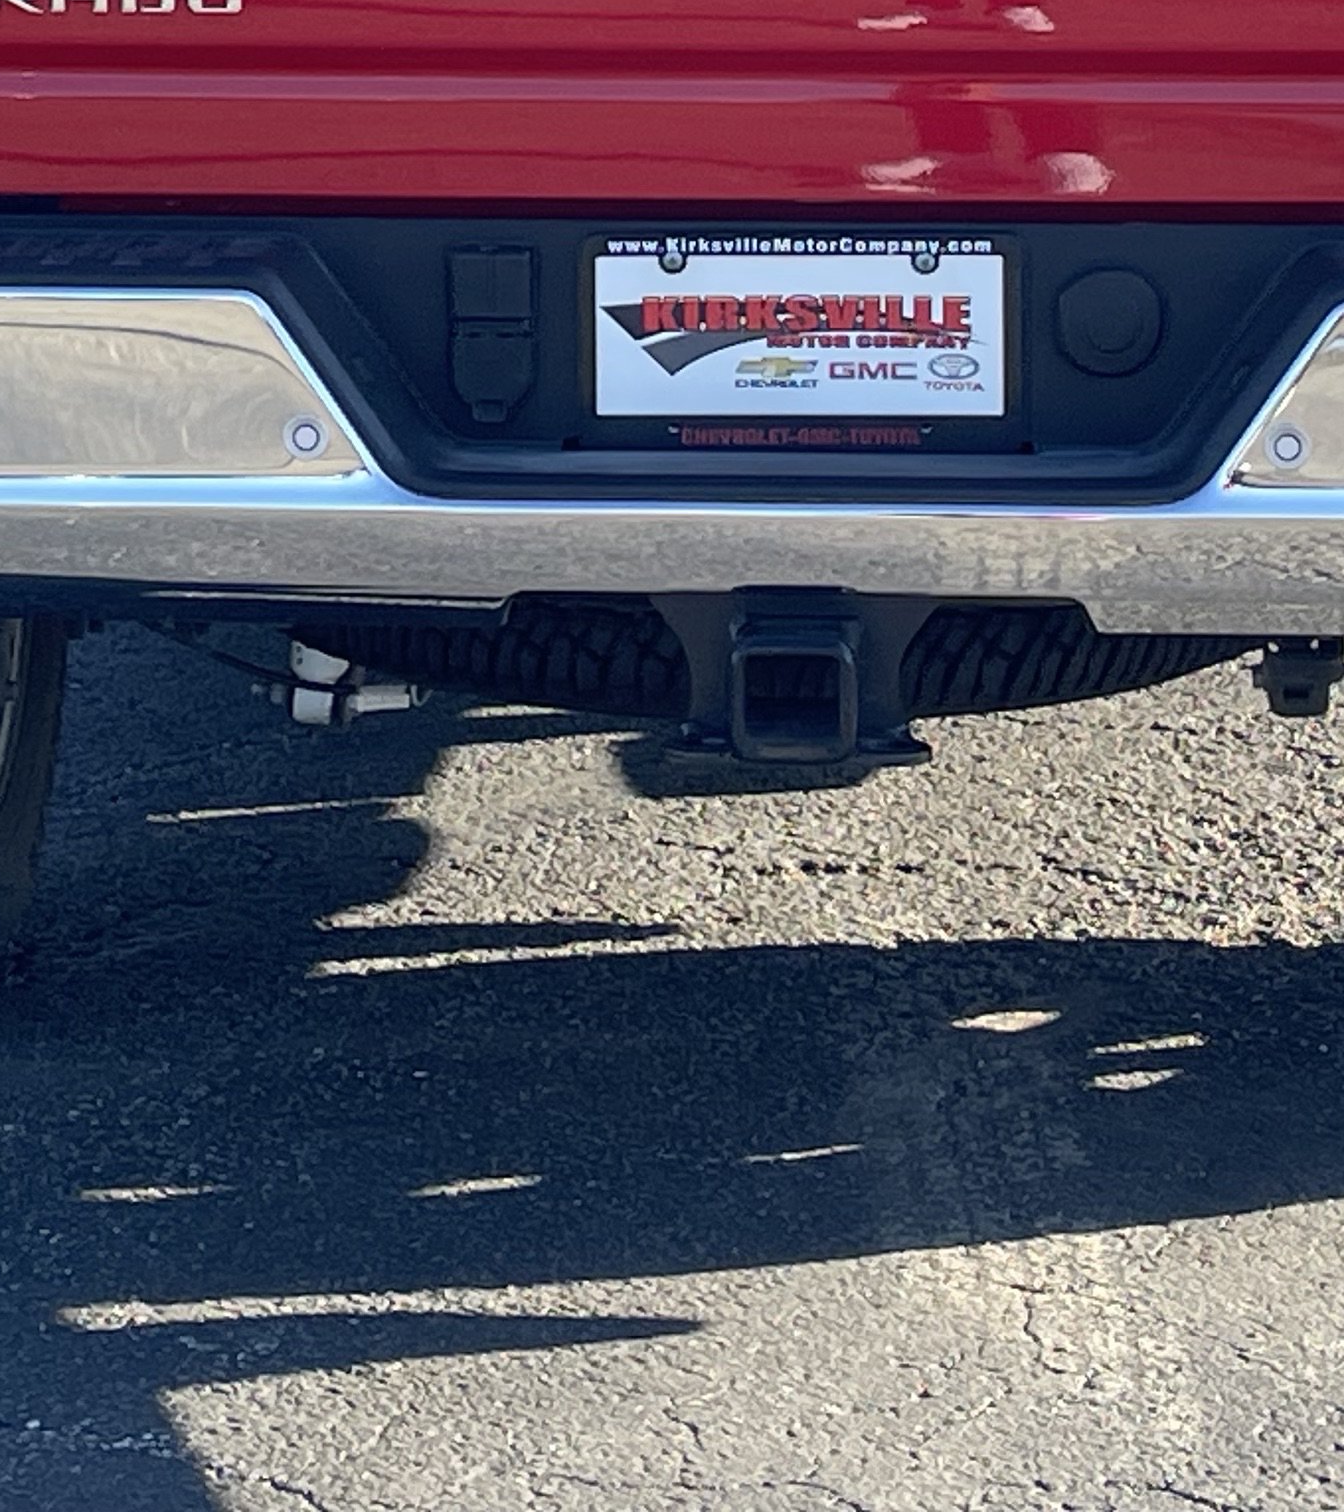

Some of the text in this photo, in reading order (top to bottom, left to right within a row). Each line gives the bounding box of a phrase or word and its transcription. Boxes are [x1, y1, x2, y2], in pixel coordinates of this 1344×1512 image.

[607, 237, 992, 255] www.KirksvilleMotorCompany.com
[642, 295, 971, 333] KIRKSVILLE
[767, 334, 850, 349] MOTOR
[829, 361, 918, 381] GMC
[734, 378, 820, 389] CHEVROLET
[923, 380, 985, 392] TOYOTA
